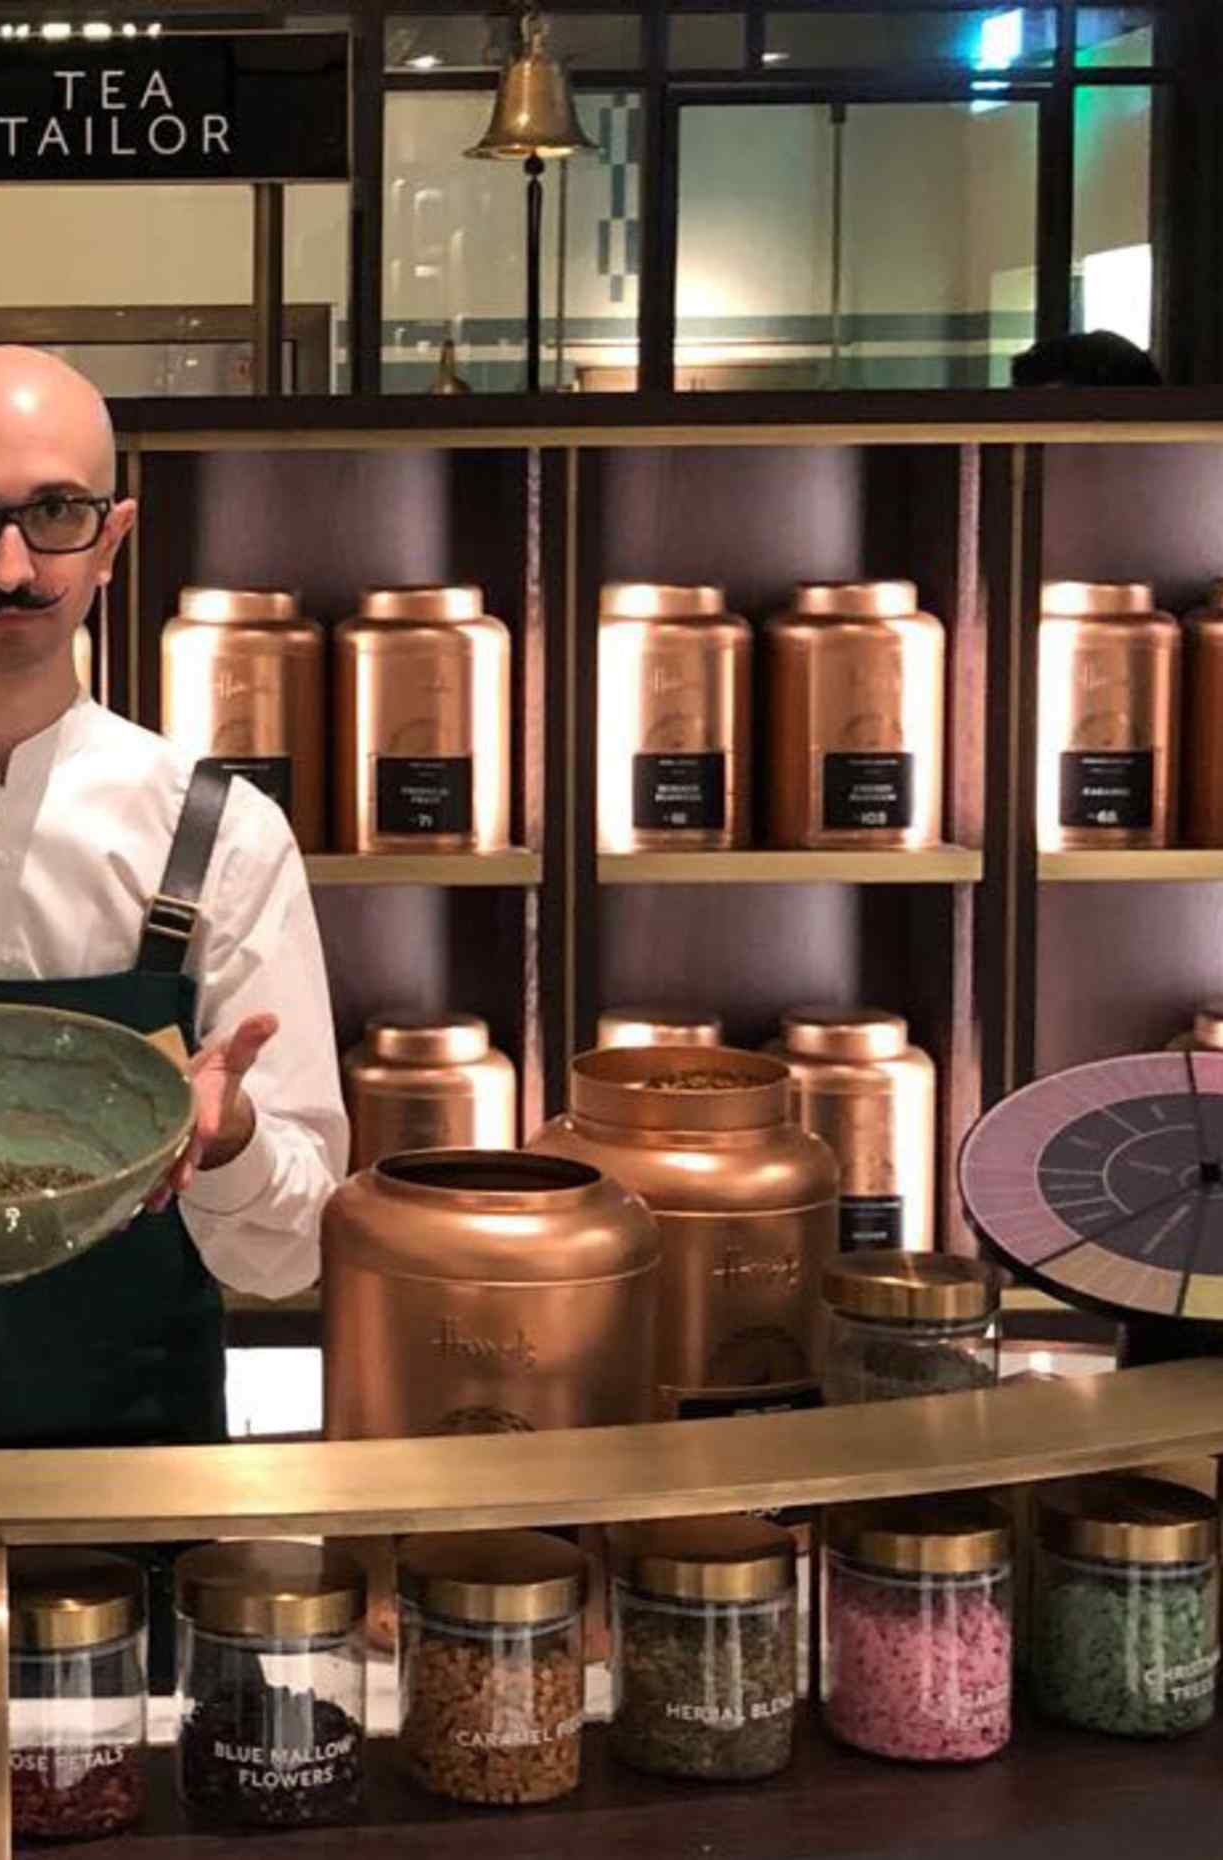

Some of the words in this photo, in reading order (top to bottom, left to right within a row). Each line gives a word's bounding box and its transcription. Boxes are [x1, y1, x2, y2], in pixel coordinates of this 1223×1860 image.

[53, 69, 173, 111] TEA
[9, 1752, 49, 1773] OSE
[54, 1744, 124, 1770] PETALS
[213, 1740, 264, 1764] BLUE
[270, 1734, 356, 1764] MALLOW
[238, 1764, 334, 1789] FLOWERS
